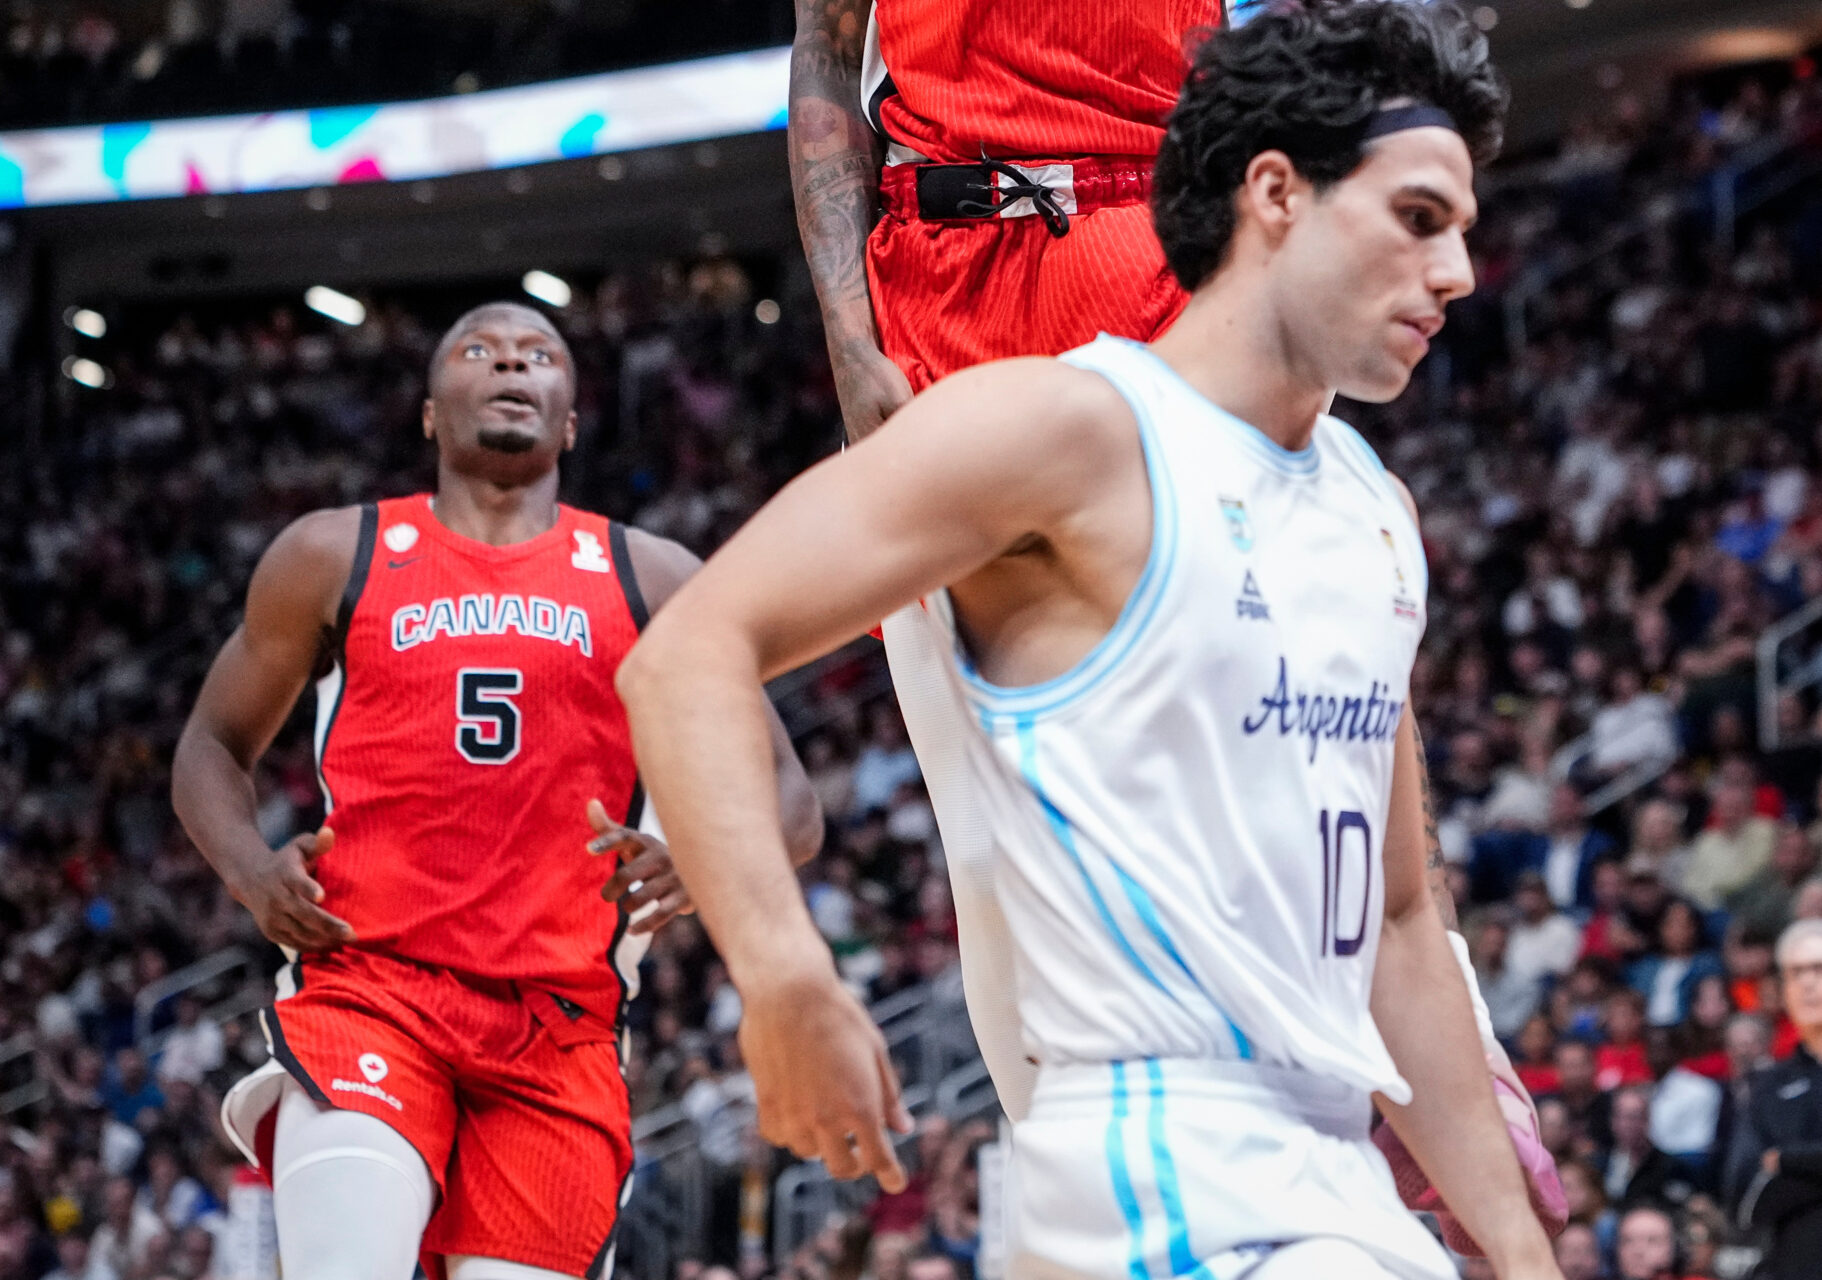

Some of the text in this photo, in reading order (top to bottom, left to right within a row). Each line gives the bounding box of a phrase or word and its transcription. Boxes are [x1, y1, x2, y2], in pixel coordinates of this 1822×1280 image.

[391, 592, 593, 658] CANADA
[455, 667, 523, 765] 5
[1318, 809, 1371, 958] 10
